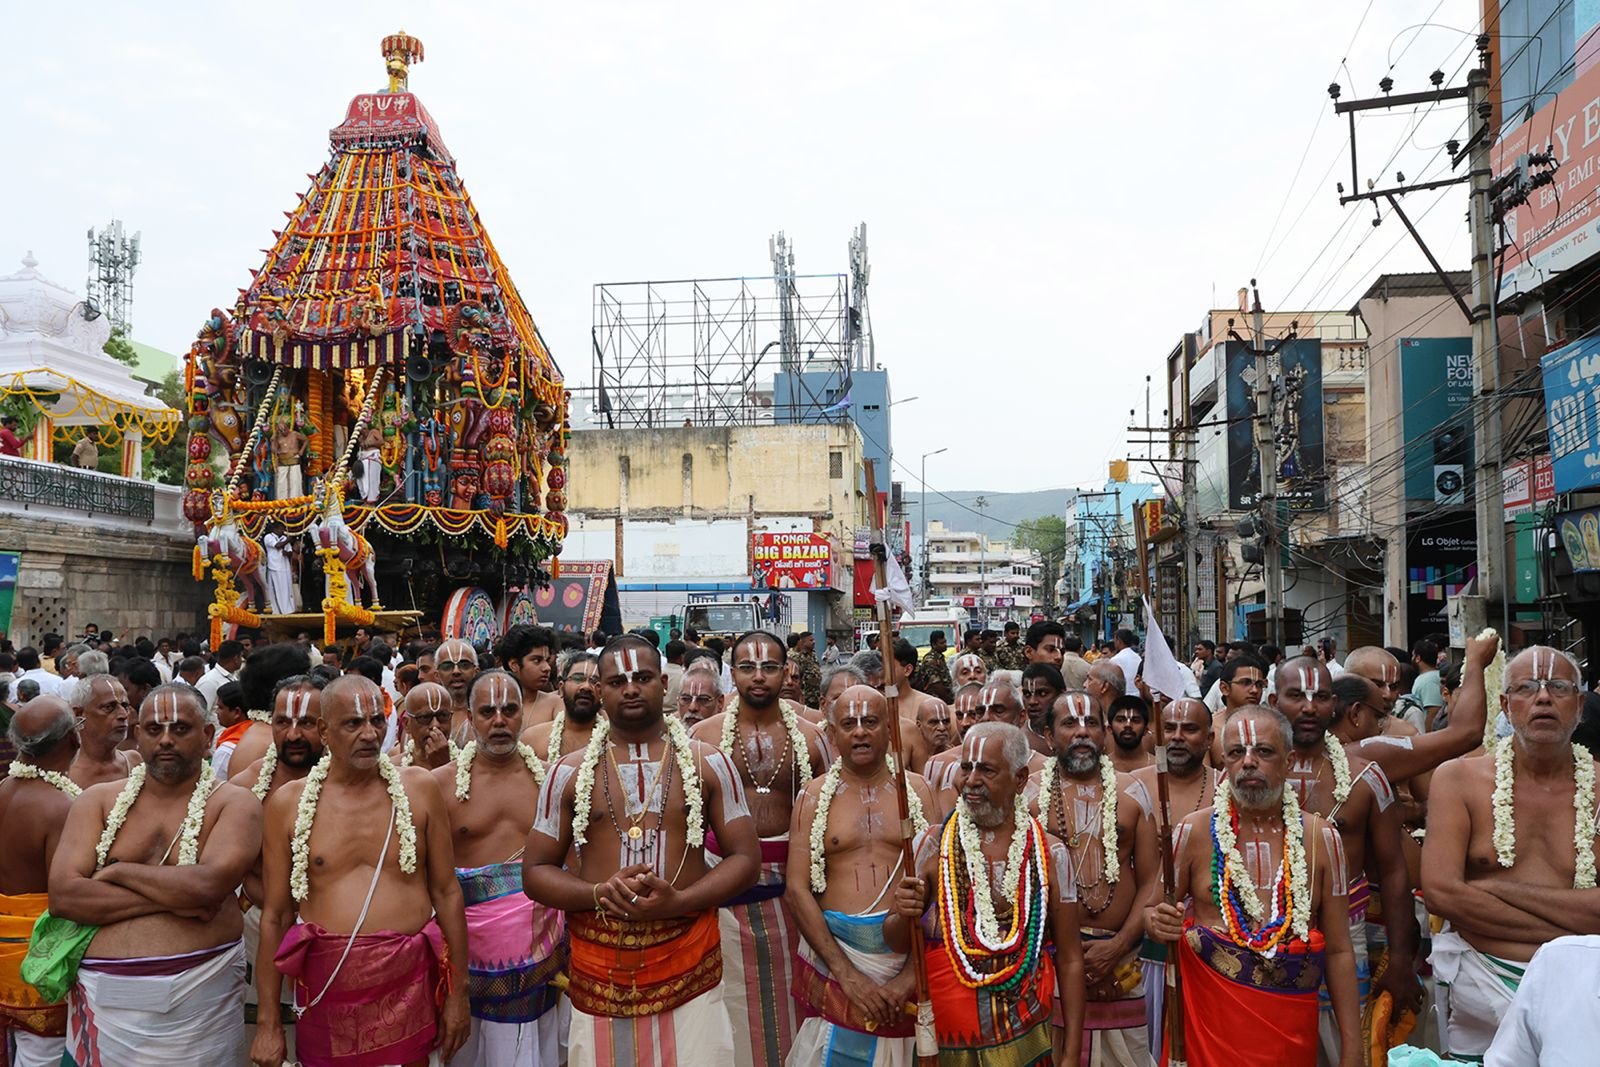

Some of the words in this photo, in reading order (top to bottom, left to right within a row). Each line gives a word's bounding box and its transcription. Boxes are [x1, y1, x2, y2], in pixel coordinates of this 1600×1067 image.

[1568, 155, 1594, 191] EMI
[1551, 242, 1570, 258] SONY
[1551, 389, 1590, 458] SRI
[773, 534, 811, 545] RONAK
[1422, 537, 1434, 546] LG
[1436, 537, 1460, 547] Objet
[754, 545, 780, 560] BIG
[782, 545, 829, 559] BAZAR
